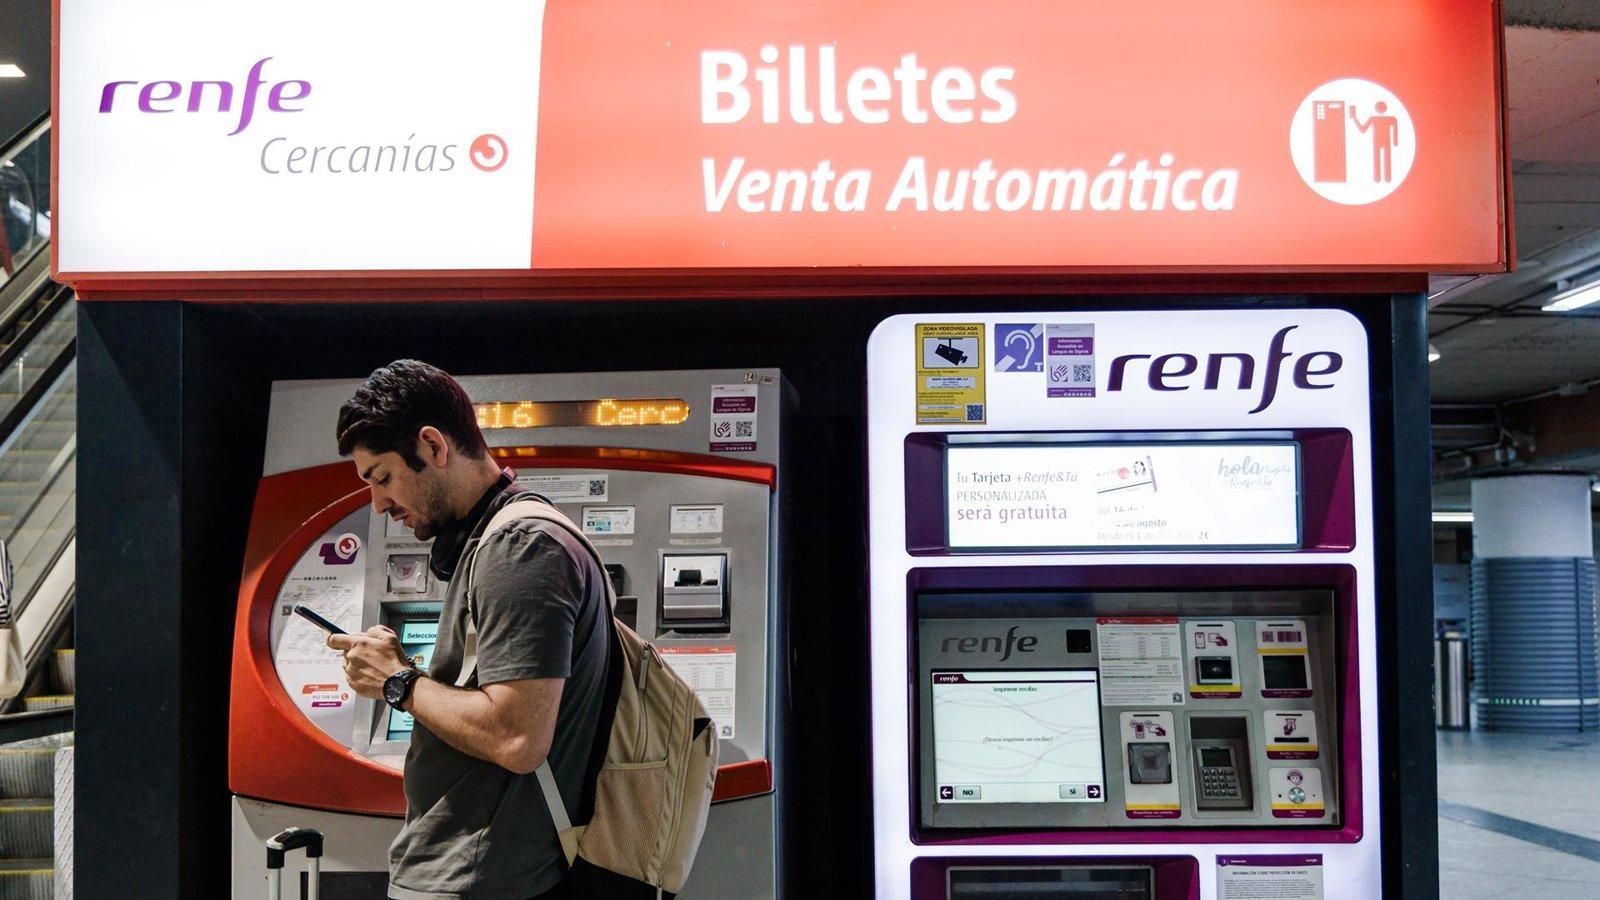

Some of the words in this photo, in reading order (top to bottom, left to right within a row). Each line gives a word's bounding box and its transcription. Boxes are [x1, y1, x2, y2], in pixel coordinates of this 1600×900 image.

[99, 57, 312, 136] renfe
[700, 45, 1018, 124] Billetes
[260, 133, 456, 174] Cercanías
[702, 157, 871, 212] Venta
[886, 153, 1239, 212] Automática
[1107, 325, 1343, 414] renfe
[956, 490, 1047, 501] PERSONALIZADA
[957, 472, 968, 483] Tu
[972, 472, 1011, 485] Tarjeta
[957, 504, 992, 520] será
[998, 504, 1067, 523] gratuita
[941, 625, 1038, 662] renfe
